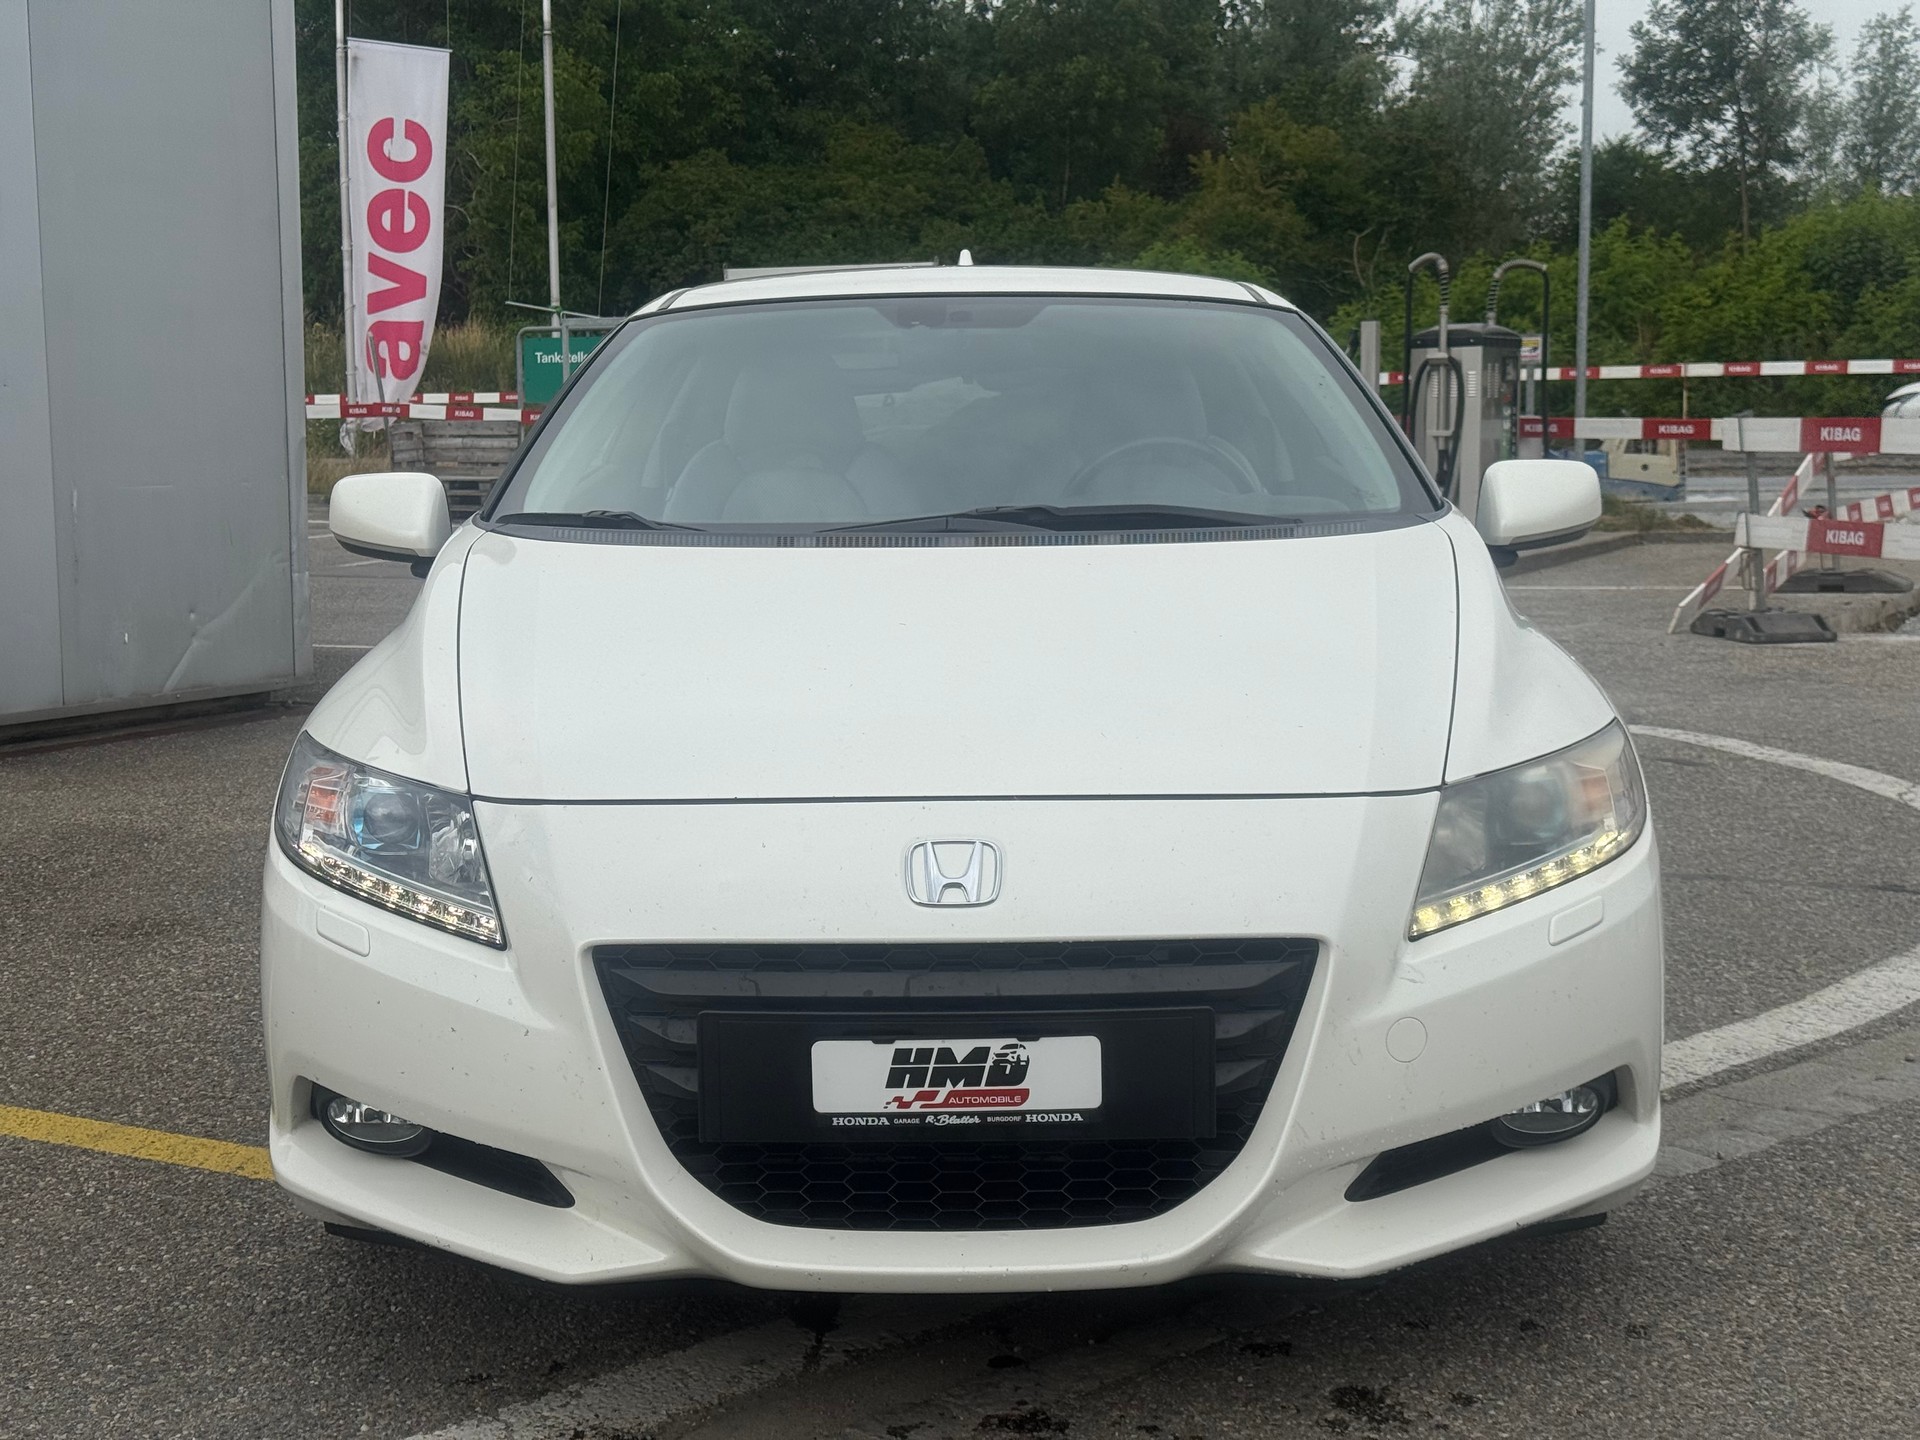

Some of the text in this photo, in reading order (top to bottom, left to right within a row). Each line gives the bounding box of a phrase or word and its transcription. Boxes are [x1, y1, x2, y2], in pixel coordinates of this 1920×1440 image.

[366, 117, 433, 381] avec
[1658, 424, 1695, 435] KIBAG
[1820, 427, 1861, 442] KIBAG
[1825, 529, 1865, 545] KIBAG
[948, 1095, 1022, 1104] AUTOMOBILE
[832, 1117, 890, 1126] HONDA
[1025, 1113, 1084, 1123] HONDA
